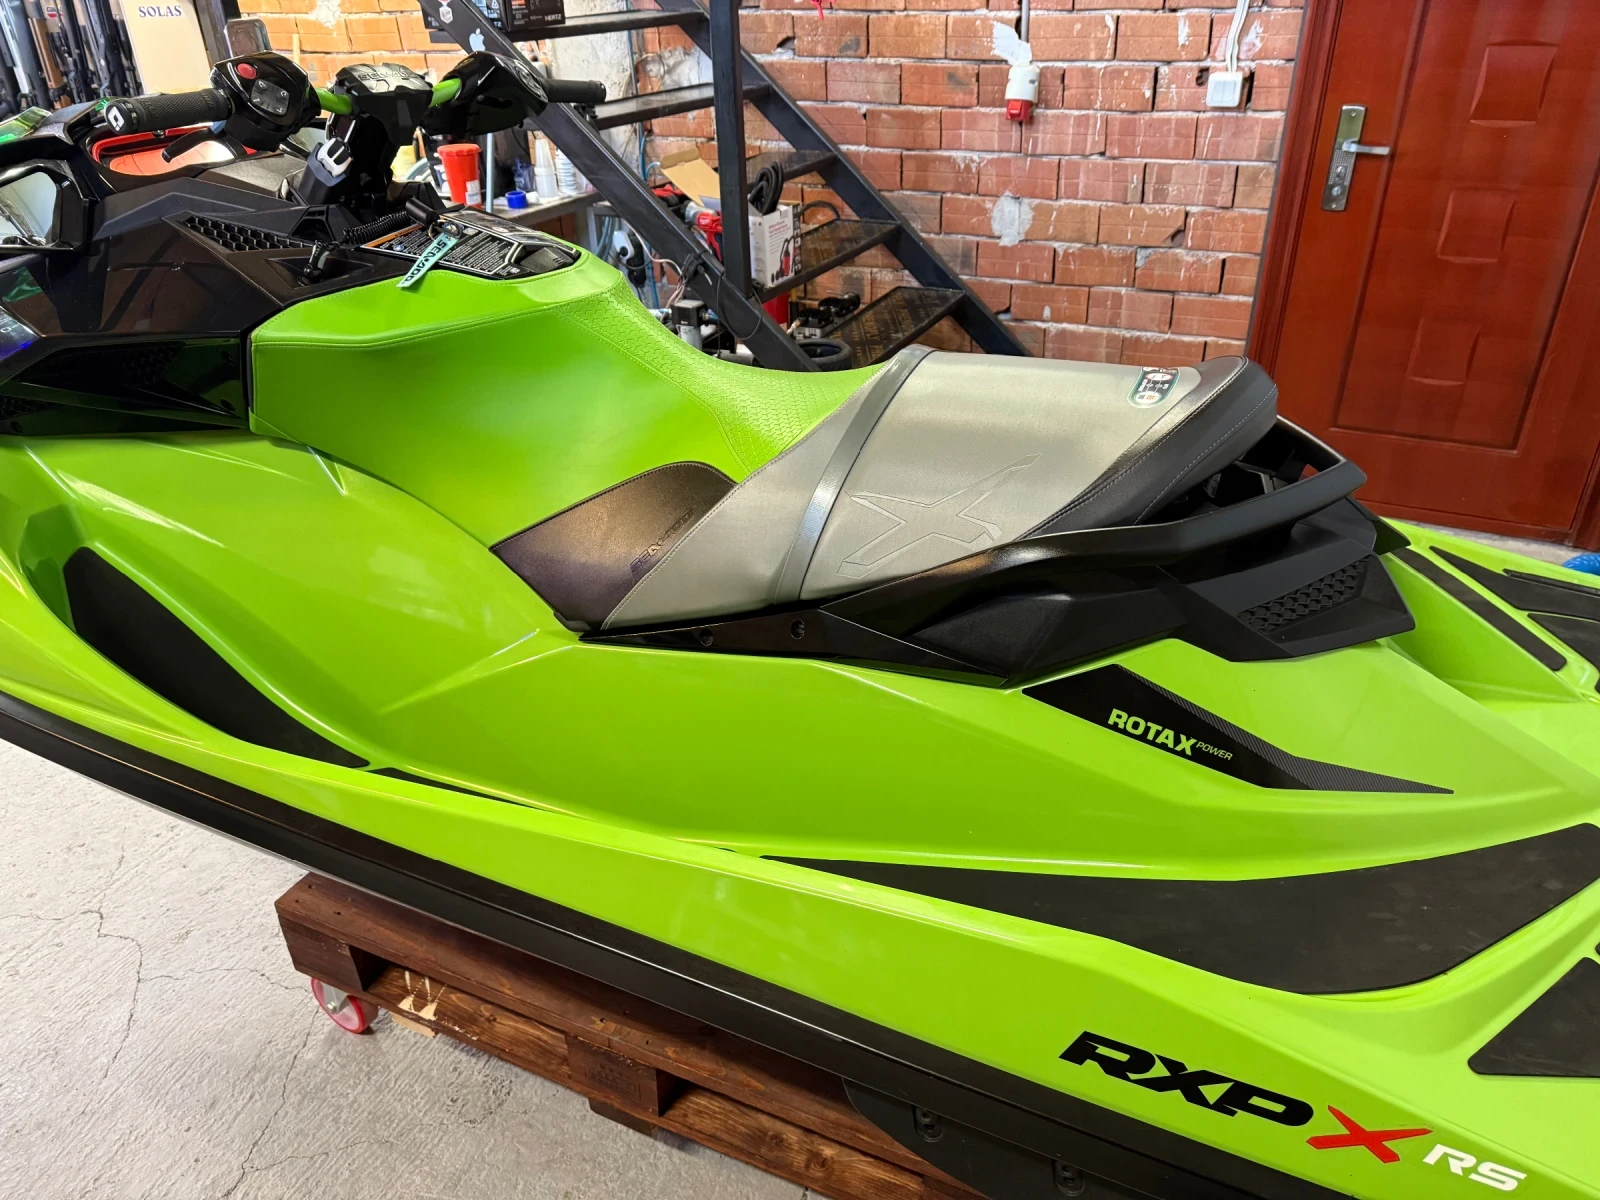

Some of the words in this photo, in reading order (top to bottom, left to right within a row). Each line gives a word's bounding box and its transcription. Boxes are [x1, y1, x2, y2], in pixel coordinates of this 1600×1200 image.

[138, 5, 182, 18] SOLAS
[1107, 708, 1197, 756] ROTAX
[1195, 741, 1233, 760] POWER
[1422, 1144, 1527, 1191] RS
